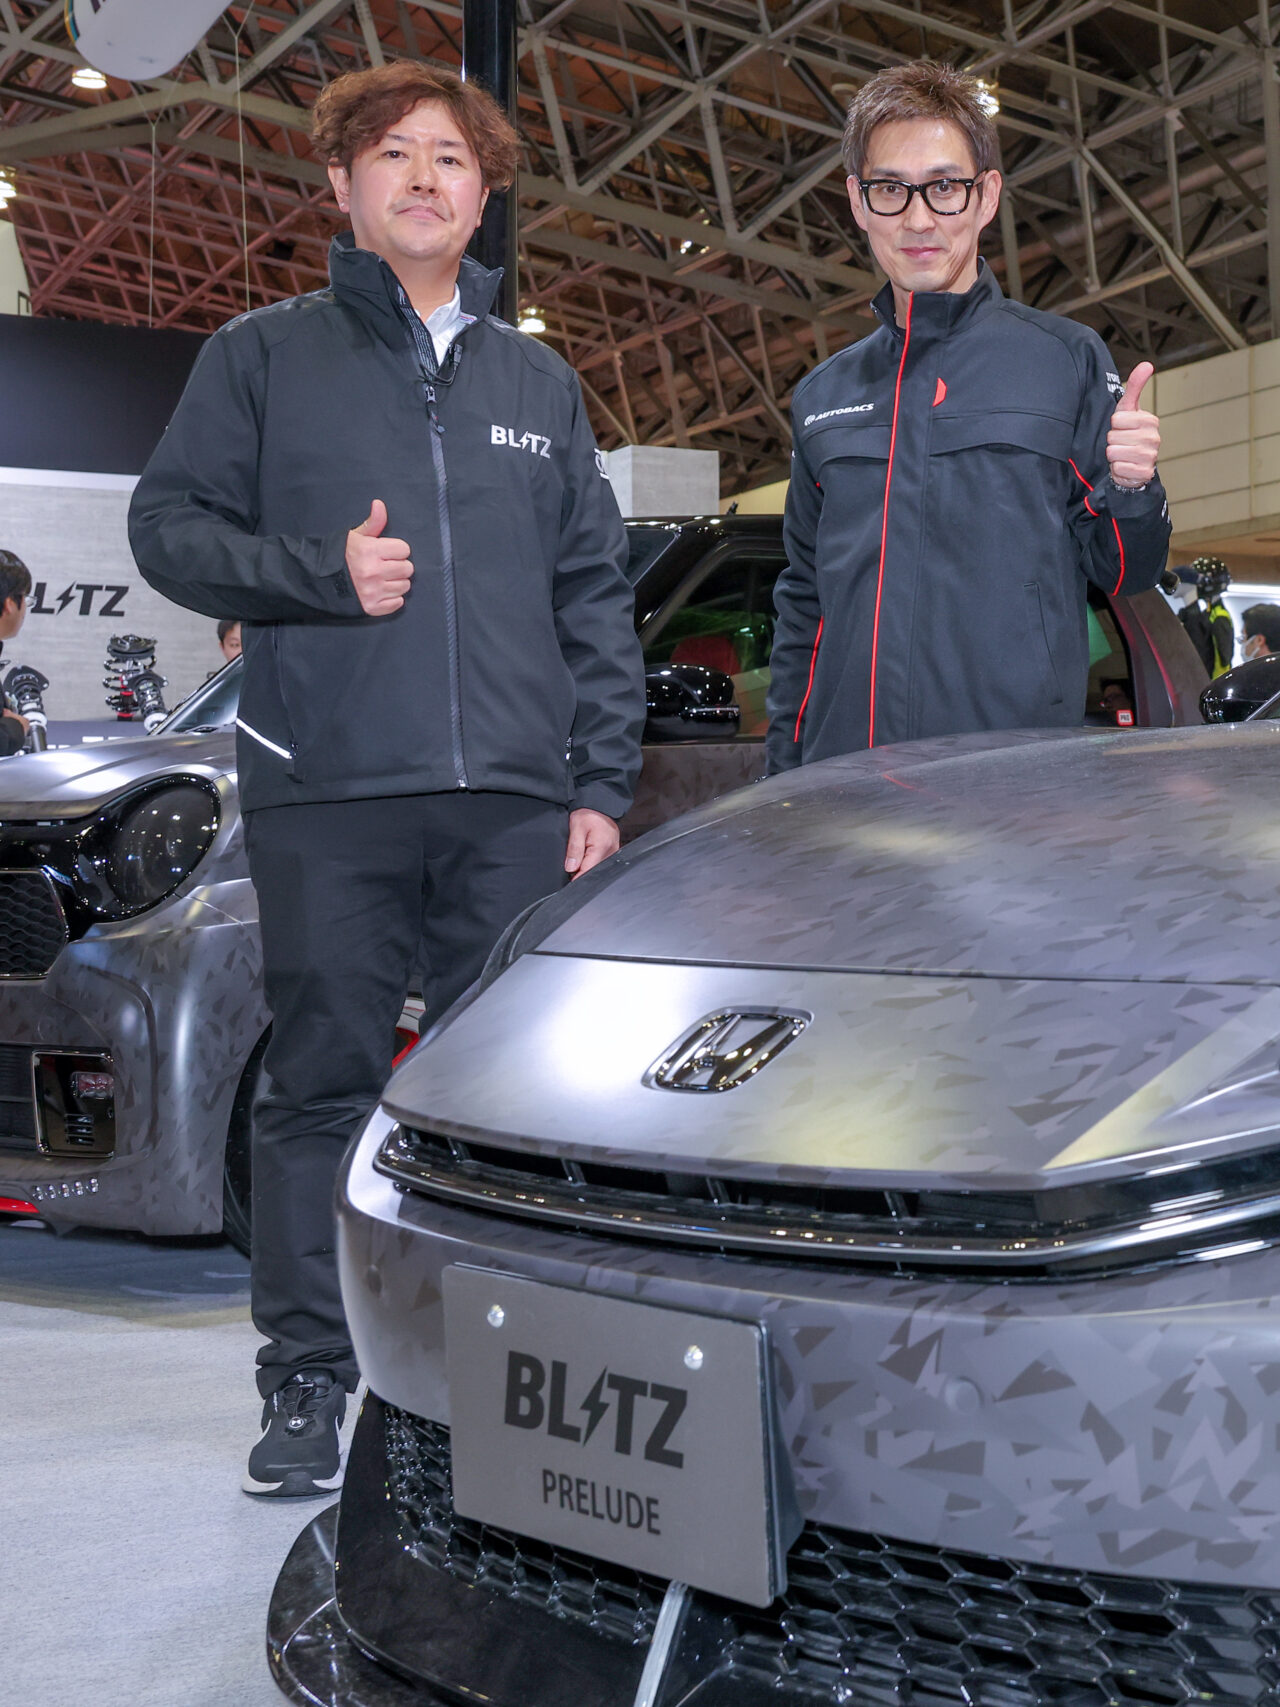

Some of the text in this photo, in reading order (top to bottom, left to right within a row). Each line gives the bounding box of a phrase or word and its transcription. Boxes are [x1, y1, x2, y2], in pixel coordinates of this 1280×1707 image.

[815, 403, 875, 421] AUTOBACS
[491, 424, 551, 459] BLITZ
[30, 581, 130, 617] LITZ
[504, 1350, 688, 1469] BLITZ
[542, 1469, 661, 1535] PRELUDE
